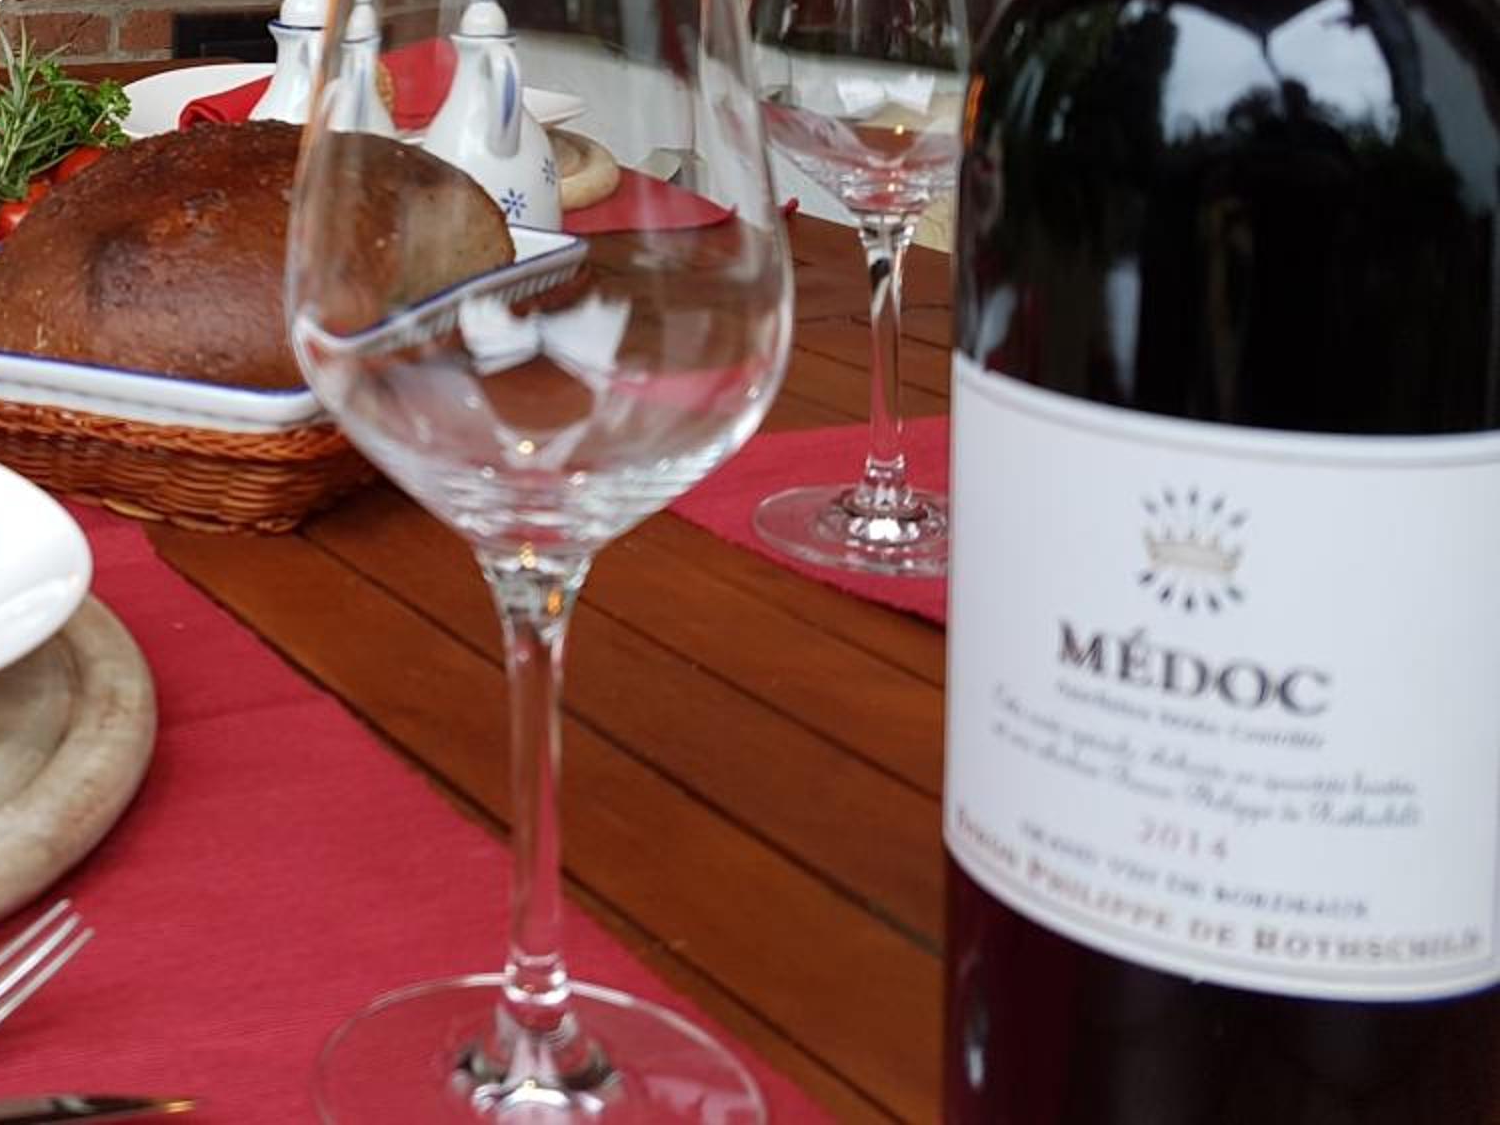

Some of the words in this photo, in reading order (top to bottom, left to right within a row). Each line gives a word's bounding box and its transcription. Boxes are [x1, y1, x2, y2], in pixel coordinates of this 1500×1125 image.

[1057, 618, 1333, 718] MÉDOC
[1136, 818, 1231, 862] 2014
[1189, 915, 1236, 948] DE
